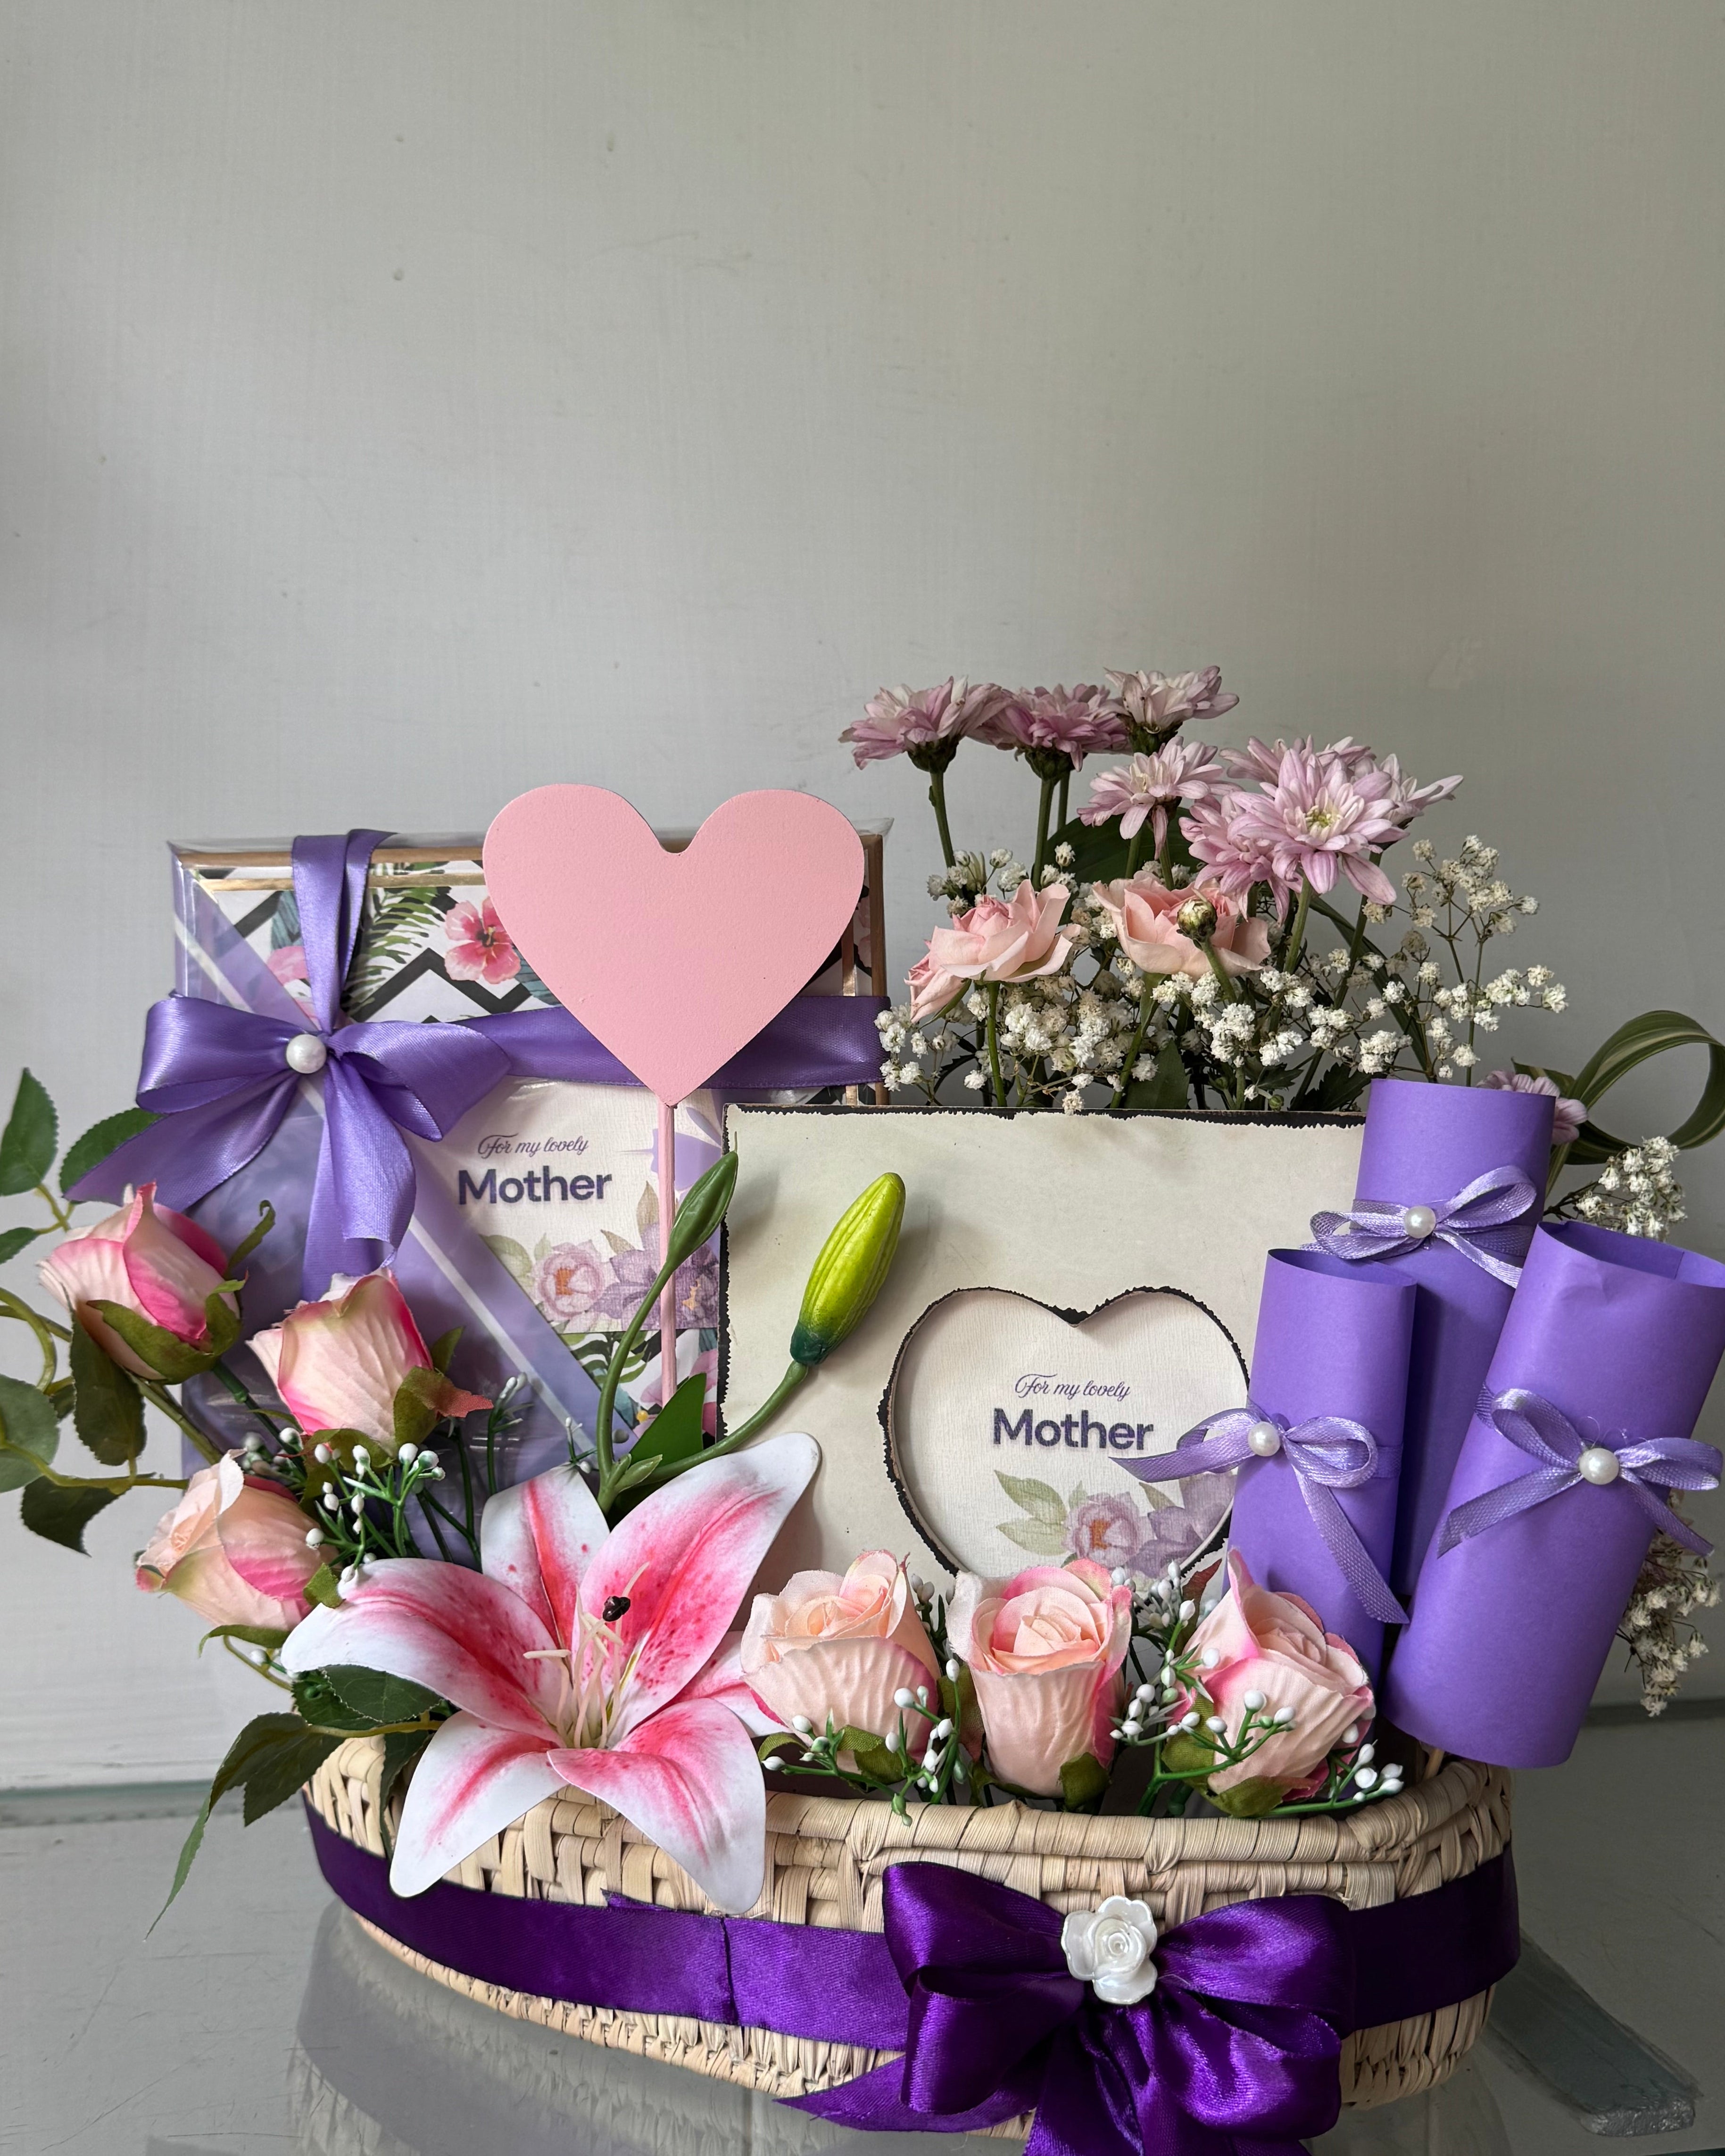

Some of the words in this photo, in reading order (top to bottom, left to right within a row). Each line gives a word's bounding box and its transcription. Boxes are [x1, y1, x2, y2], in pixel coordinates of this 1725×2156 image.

[478, 1133, 518, 1159] For
[515, 1142, 541, 1157] my
[544, 1136, 589, 1155] lovely
[459, 1165, 612, 1205] Mother
[1015, 1373, 1058, 1398] For
[1053, 1384, 1080, 1400] my
[1083, 1380, 1131, 1401] lovely
[994, 1408, 1154, 1450] Mother
